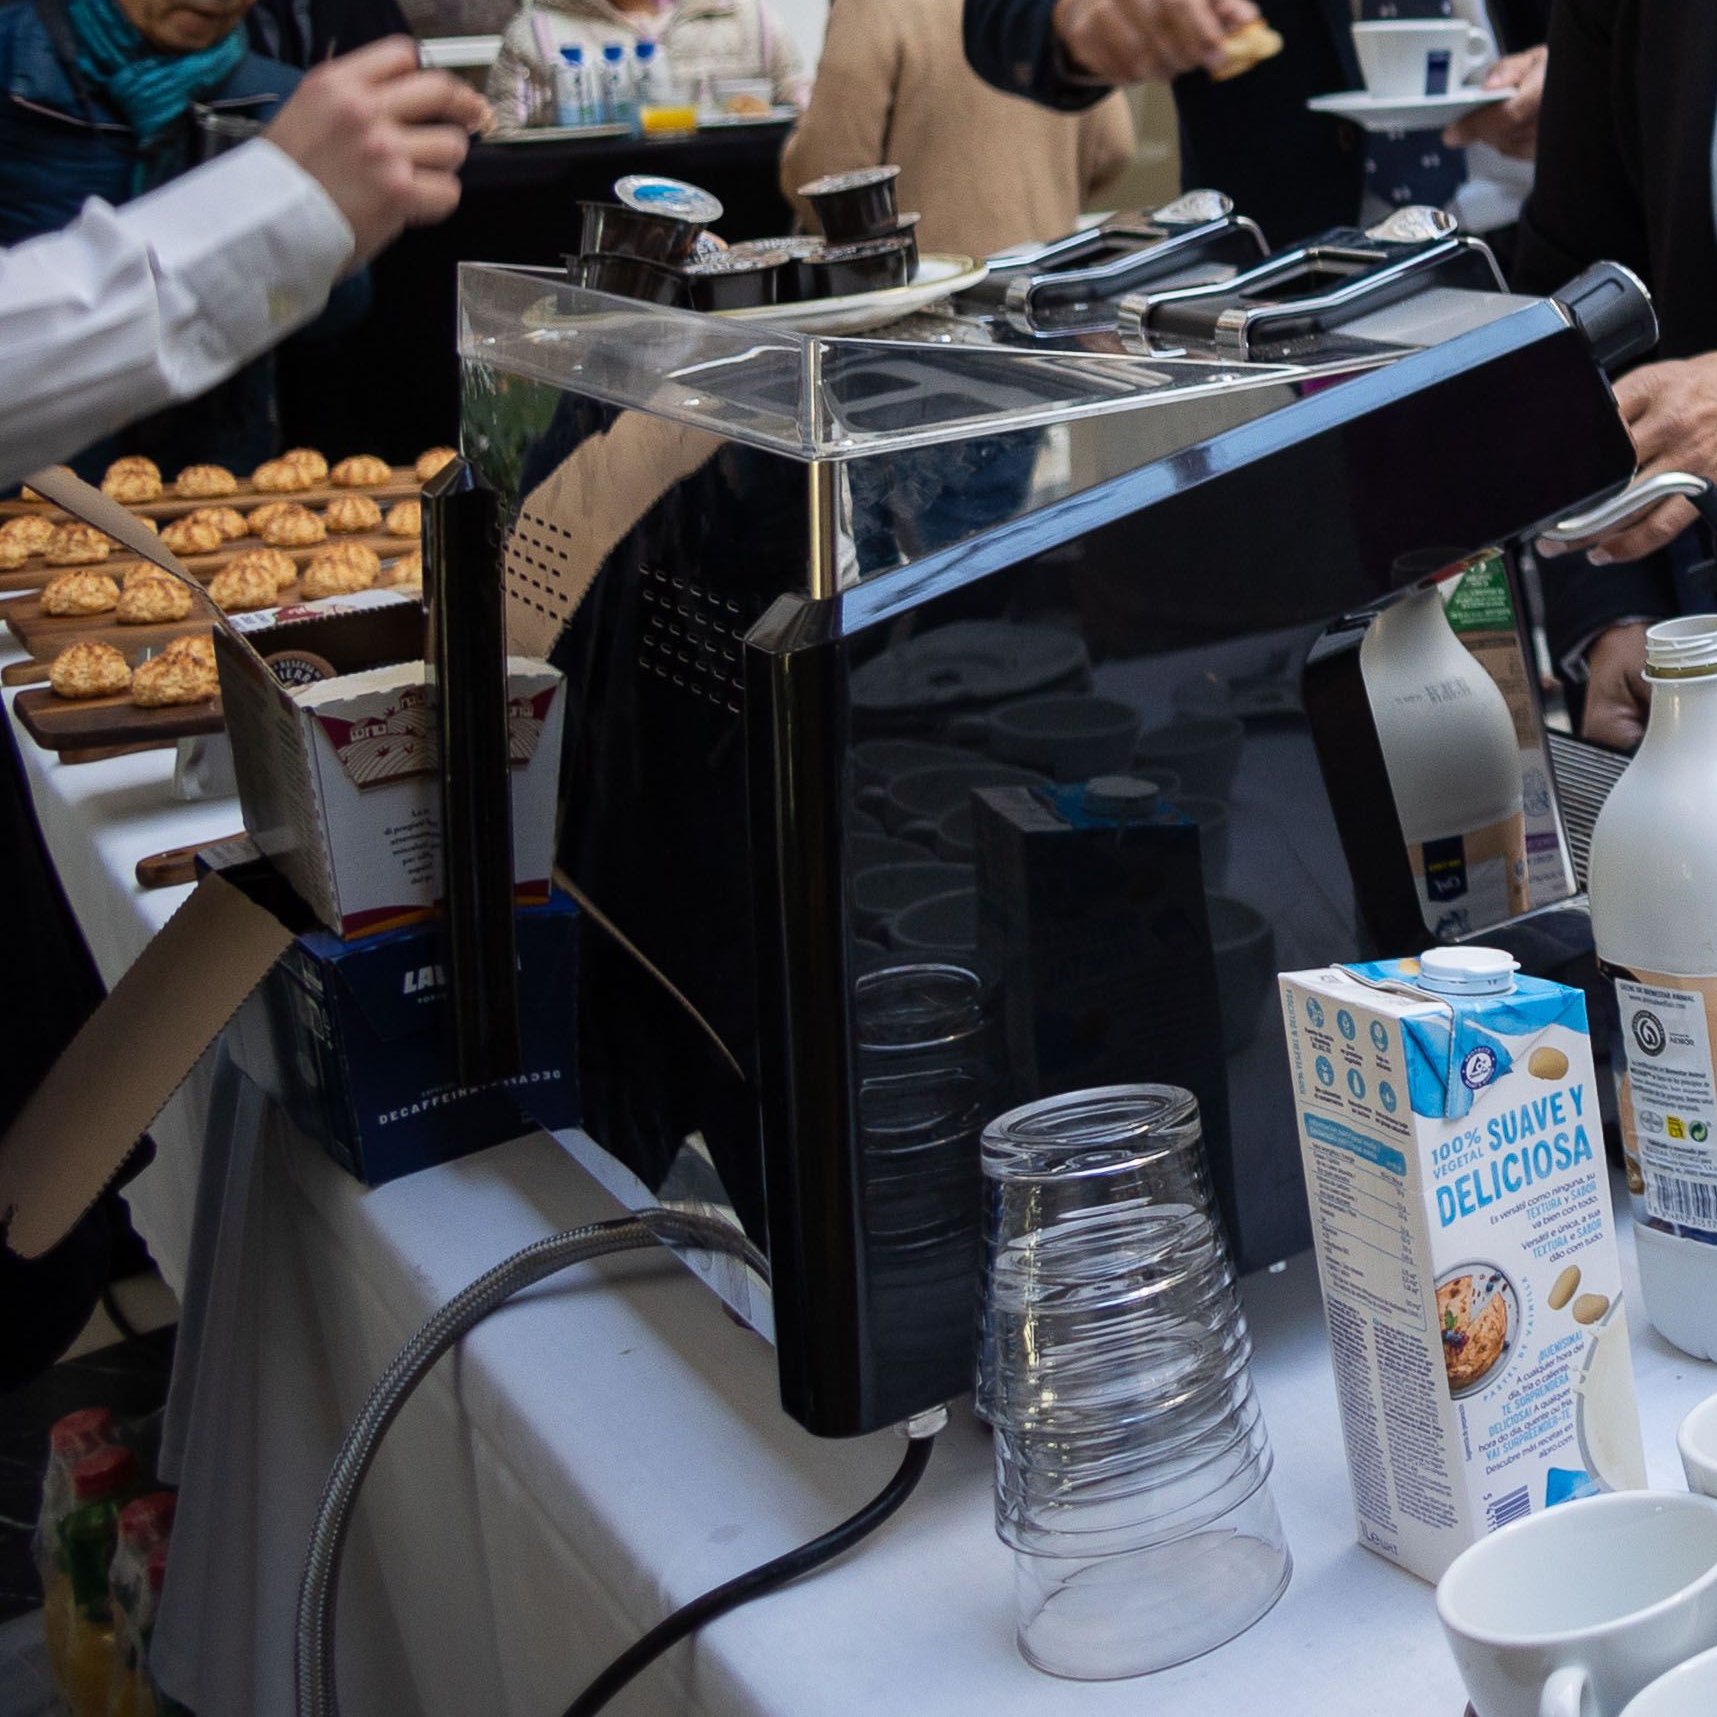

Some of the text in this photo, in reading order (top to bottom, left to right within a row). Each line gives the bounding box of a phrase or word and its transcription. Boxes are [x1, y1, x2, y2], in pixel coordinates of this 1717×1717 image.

[1488, 1091, 1566, 1151] SUAVE
[1569, 1083, 1583, 1118] Y
[1432, 1128, 1482, 1165] 100%
[1433, 1147, 1484, 1180] VEGETAL
[1436, 1124, 1593, 1228] DELICIOSA
[1526, 1196, 1562, 1220] TEXTURA
[1570, 1180, 1598, 1201] SABOR
[1527, 1191, 1551, 1207] como
[1543, 1212, 1560, 1225] bien
[1562, 1204, 1577, 1216] con
[1533, 1235, 1569, 1259] TEXTURA
[1576, 1218, 1602, 1239] SABOR
[1557, 1350, 1573, 1364] hora
[1478, 1440, 1497, 1453] hora
[1486, 1452, 1521, 1475] Descubre
